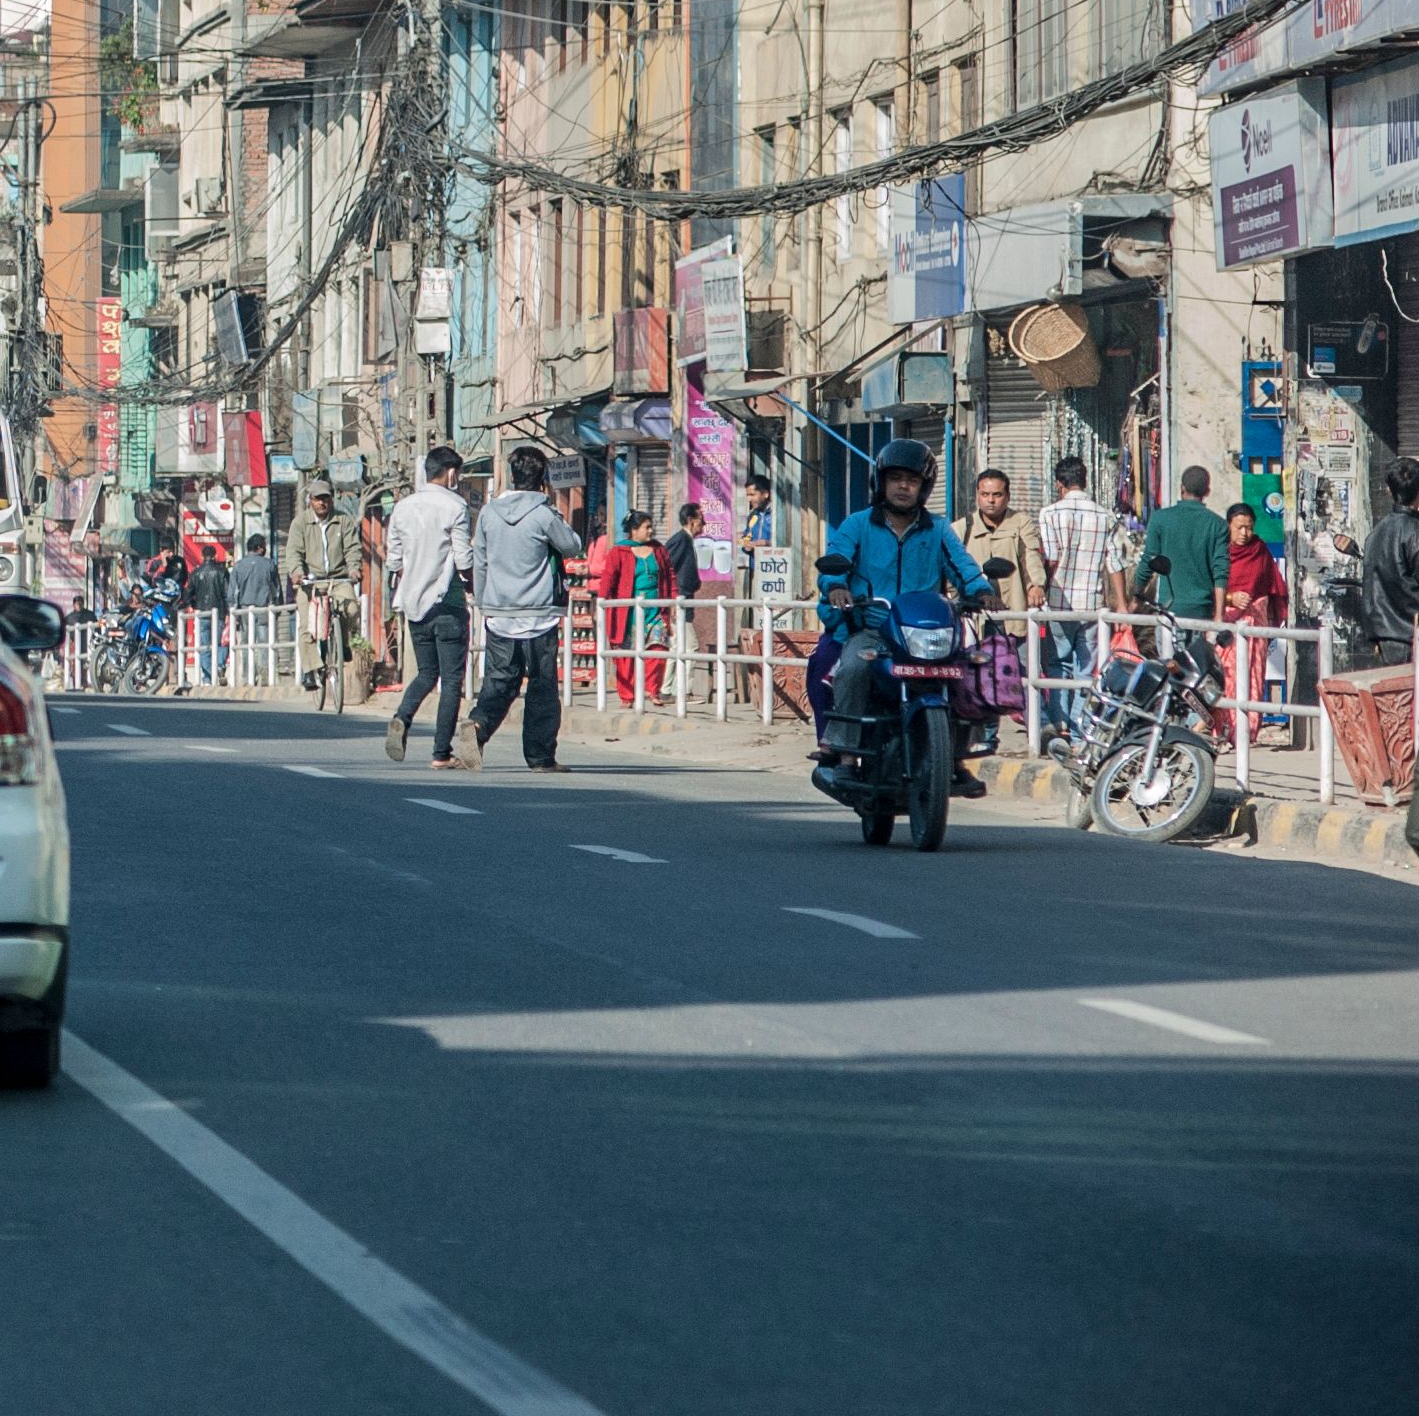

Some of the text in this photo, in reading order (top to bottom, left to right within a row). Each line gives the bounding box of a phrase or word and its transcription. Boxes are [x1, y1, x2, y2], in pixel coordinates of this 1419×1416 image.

[1252, 120, 1272, 158] Ncell
[760, 557, 788, 574] फोटो
[761, 577, 785, 594] कपी
